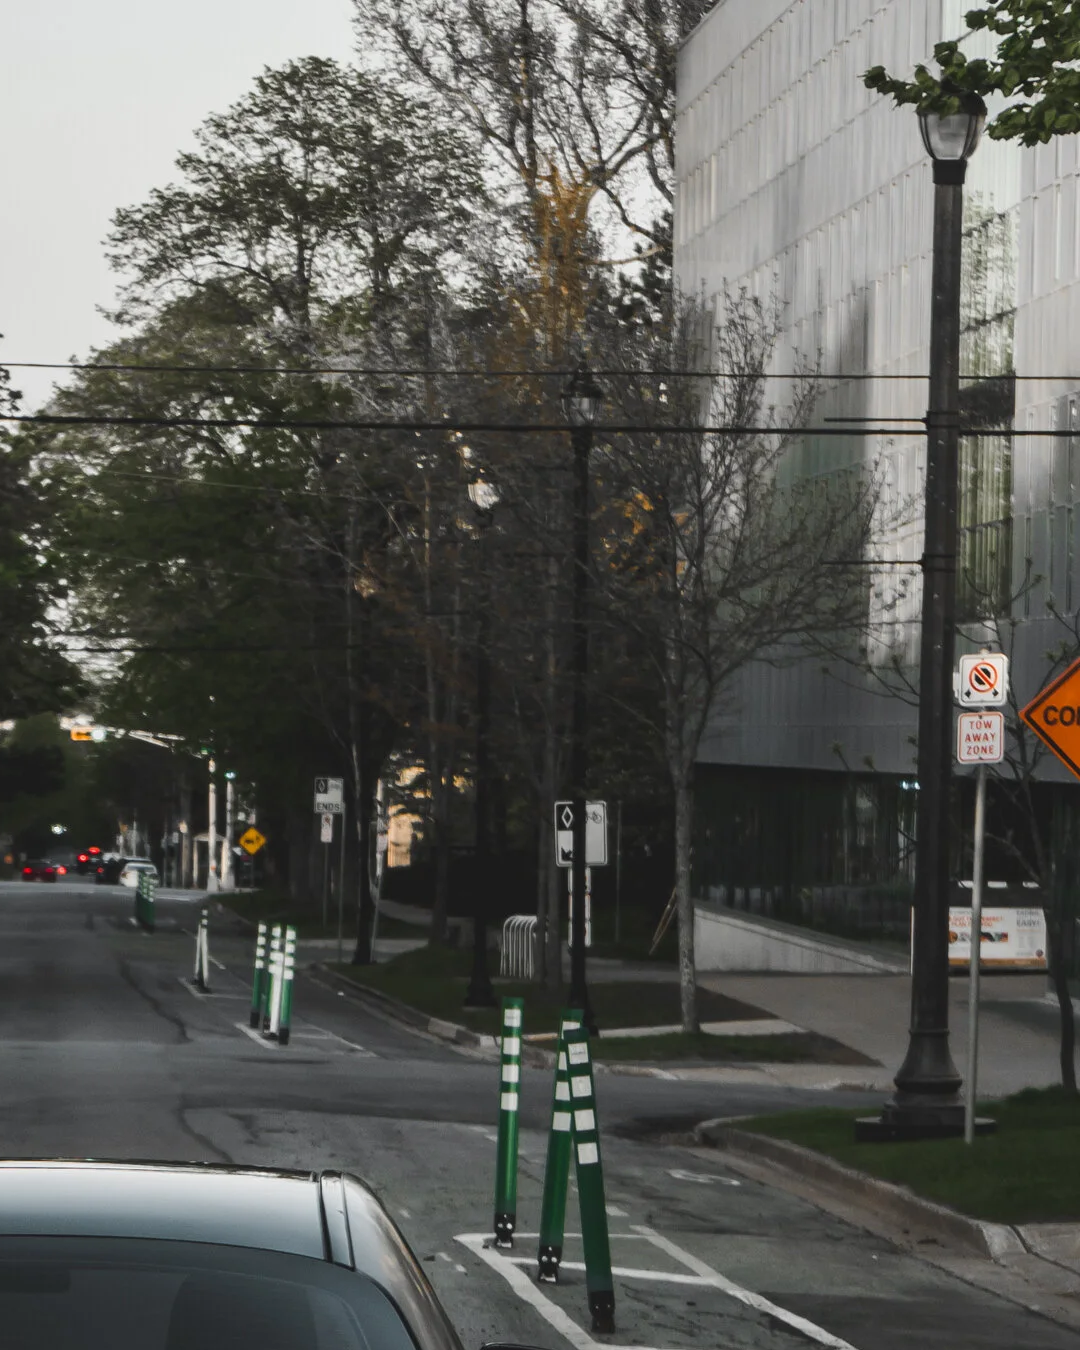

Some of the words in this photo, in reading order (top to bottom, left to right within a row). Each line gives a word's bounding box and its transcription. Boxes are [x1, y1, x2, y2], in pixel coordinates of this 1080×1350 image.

[1043, 705, 1080, 726] CO
[969, 720, 993, 729] TOW
[965, 732, 996, 742] AWAY
[966, 745, 994, 755] ZONE
[317, 803, 340, 811] ENDS
